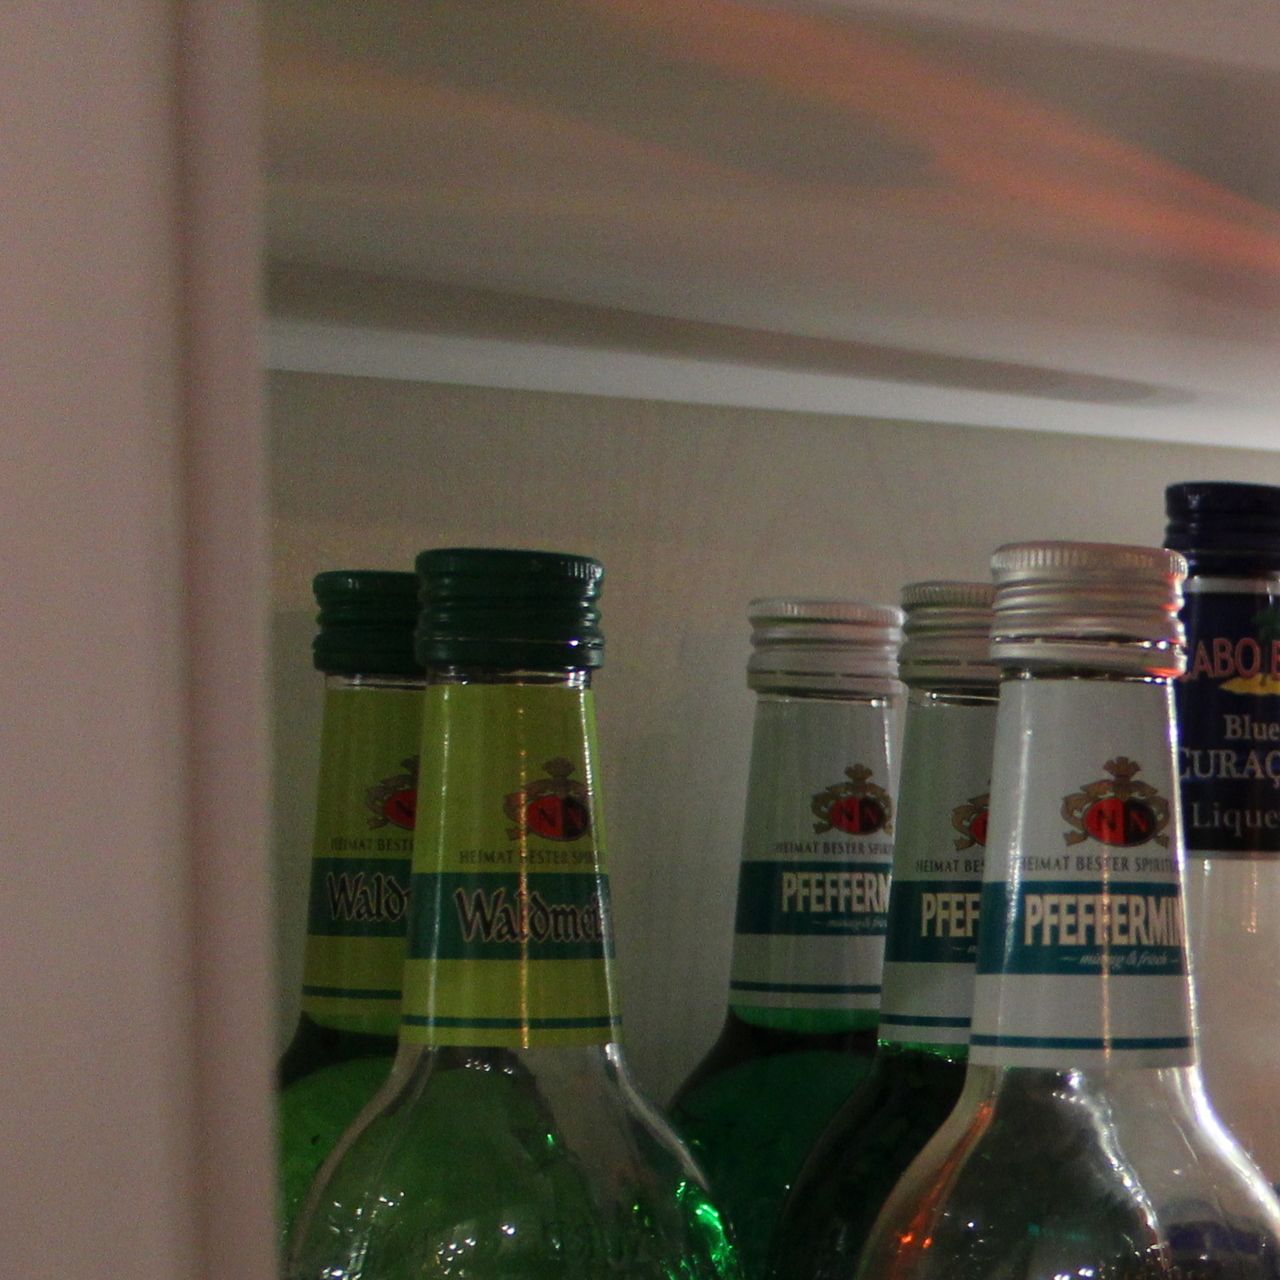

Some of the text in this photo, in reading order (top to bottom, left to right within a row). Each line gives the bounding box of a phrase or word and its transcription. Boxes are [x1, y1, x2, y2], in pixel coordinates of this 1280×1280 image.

[1223, 713, 1280, 741] Blue
[459, 850, 512, 865] HEIMAT
[520, 850, 573, 865] ESTER
[915, 858, 960, 873] HEIMAT
